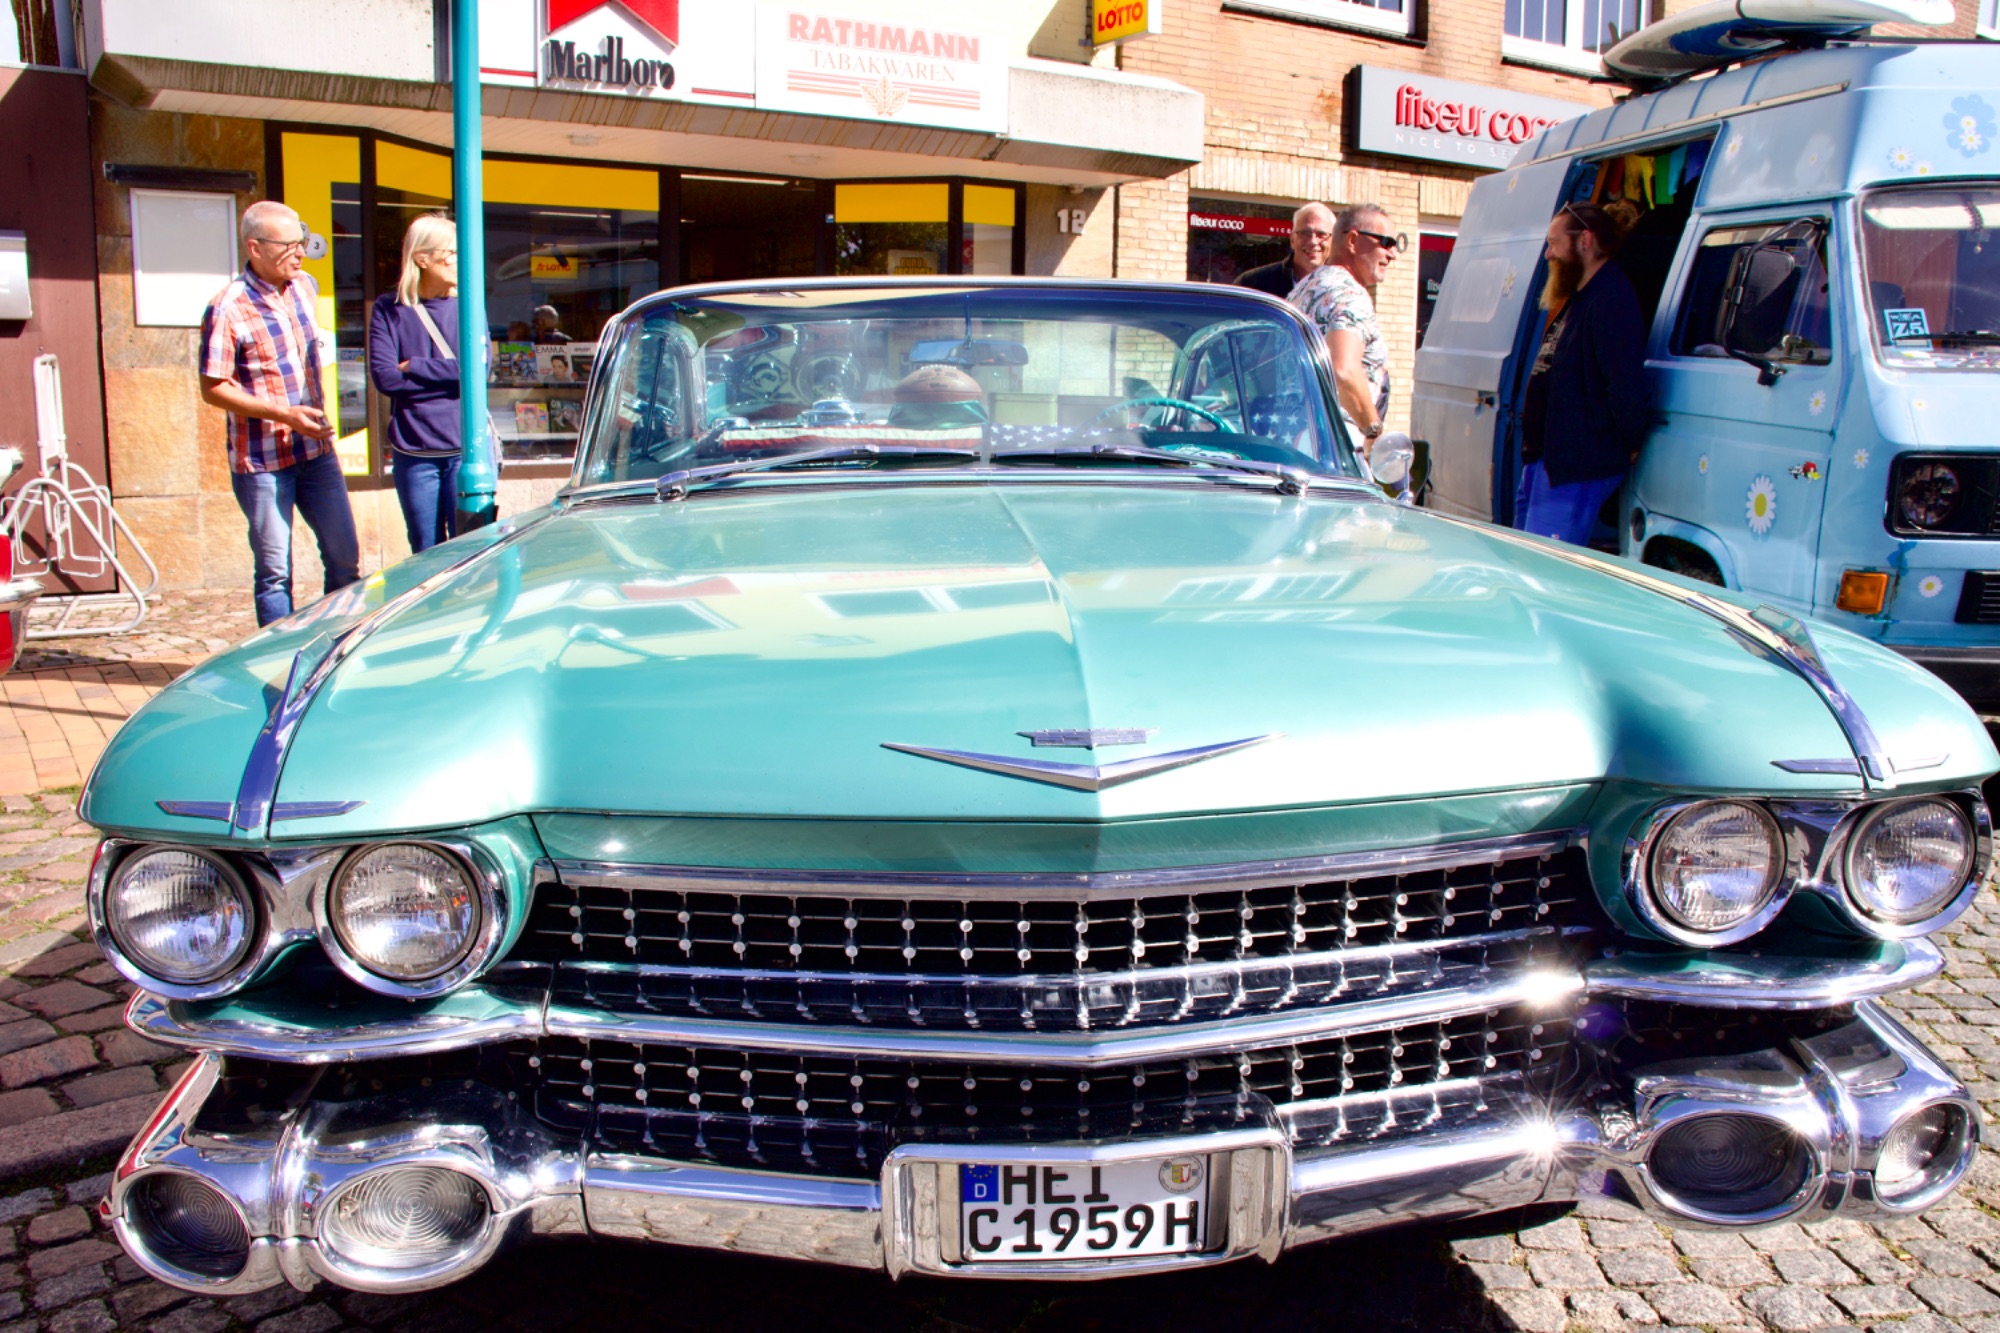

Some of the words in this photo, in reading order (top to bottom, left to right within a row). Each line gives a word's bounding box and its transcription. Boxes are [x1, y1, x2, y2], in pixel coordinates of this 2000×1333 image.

[1098, 1, 1143, 32] LOTTO
[788, 12, 980, 63] RATHMANN
[547, 35, 676, 90] Marlboro
[809, 49, 955, 82] TABAKWAREN
[1395, 84, 1486, 137] friseur
[1489, 109, 1562, 145] coc
[1395, 133, 1442, 150] NICE
[1455, 141, 1476, 154] TO
[1057, 208, 1086, 235] 12
[1190, 213, 1217, 228] friseur
[1218, 219, 1245, 231] coco
[1891, 321, 1925, 338] Z5
[974, 1183, 987, 1199] D
[1003, 1165, 1109, 1205] HEI
[968, 1200, 1198, 1253] C1959H
